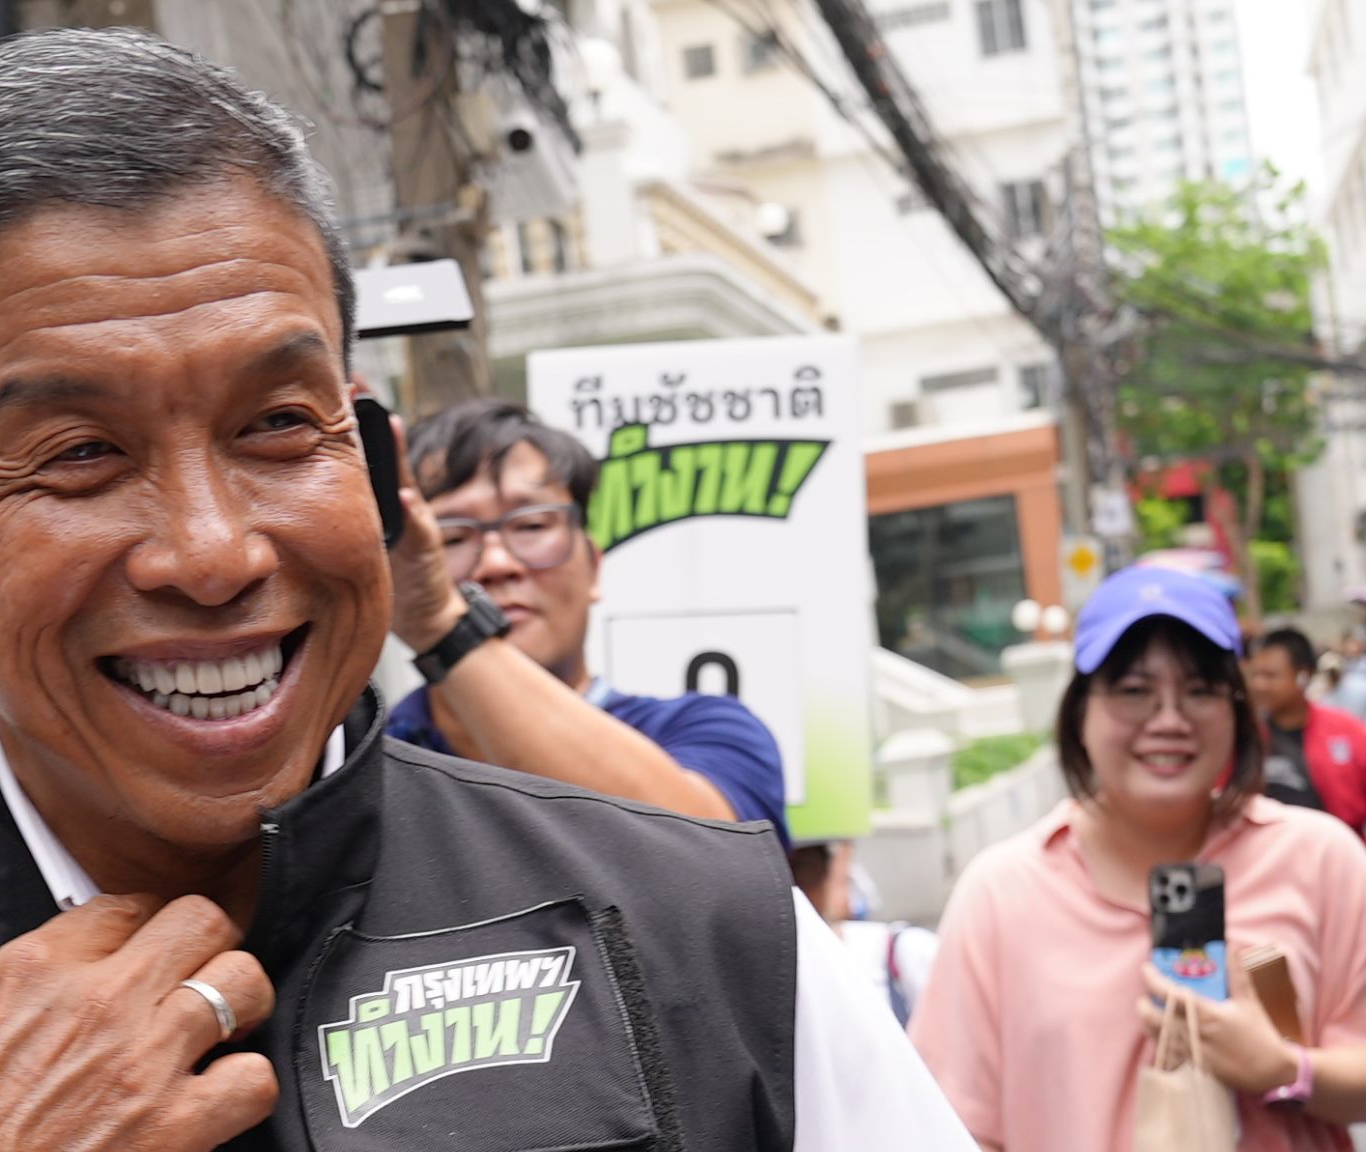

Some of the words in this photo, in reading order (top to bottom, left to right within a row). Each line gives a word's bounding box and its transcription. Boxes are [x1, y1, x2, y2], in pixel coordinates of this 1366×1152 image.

[570, 364, 826, 428] ทีมชัชชาติ
[392, 954, 567, 1016] กรุงเทพฯ
[326, 988, 568, 1114] ทำงาน!
